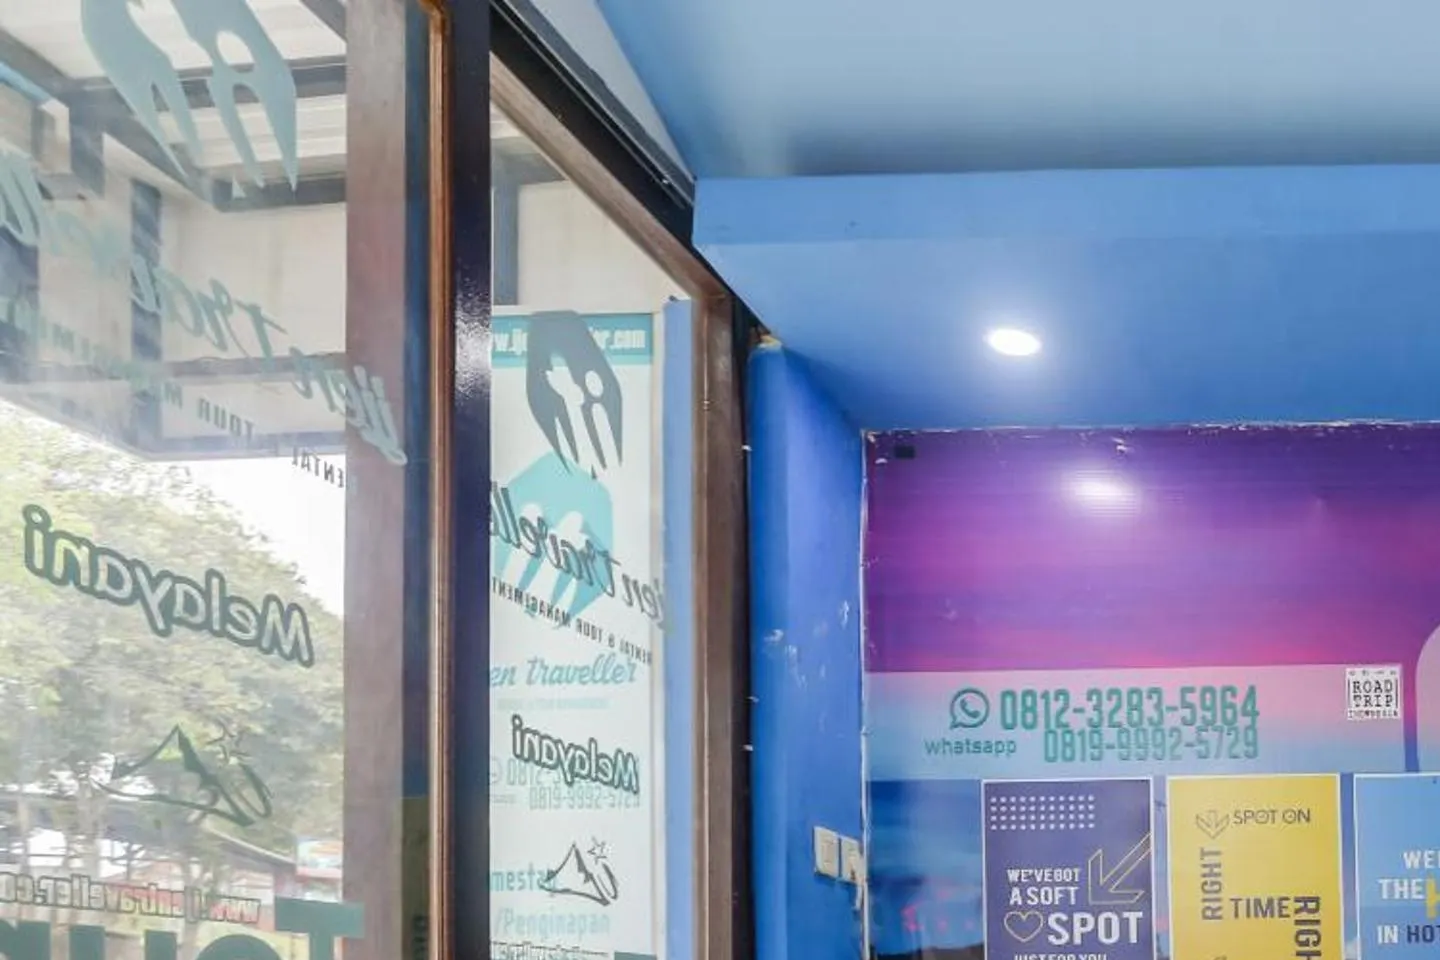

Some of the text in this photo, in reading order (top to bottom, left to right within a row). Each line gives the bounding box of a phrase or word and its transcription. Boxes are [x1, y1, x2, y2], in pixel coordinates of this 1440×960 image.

[1353, 679, 1393, 694] ROAD
[1000, 684, 1260, 731] 0812-3283-5964
[925, 737, 1017, 756] whatsapp
[1043, 726, 1259, 763] 0819-9992-5729
[1233, 808, 1311, 825] SPOT ON
[1200, 848, 1223, 920] RIGHT
[1378, 879, 1424, 900] THE
[1010, 886, 1079, 905] A SOFT
[1229, 897, 1291, 919] TIME
[1048, 911, 1143, 945] SPOT
[1377, 924, 1399, 944] IN
